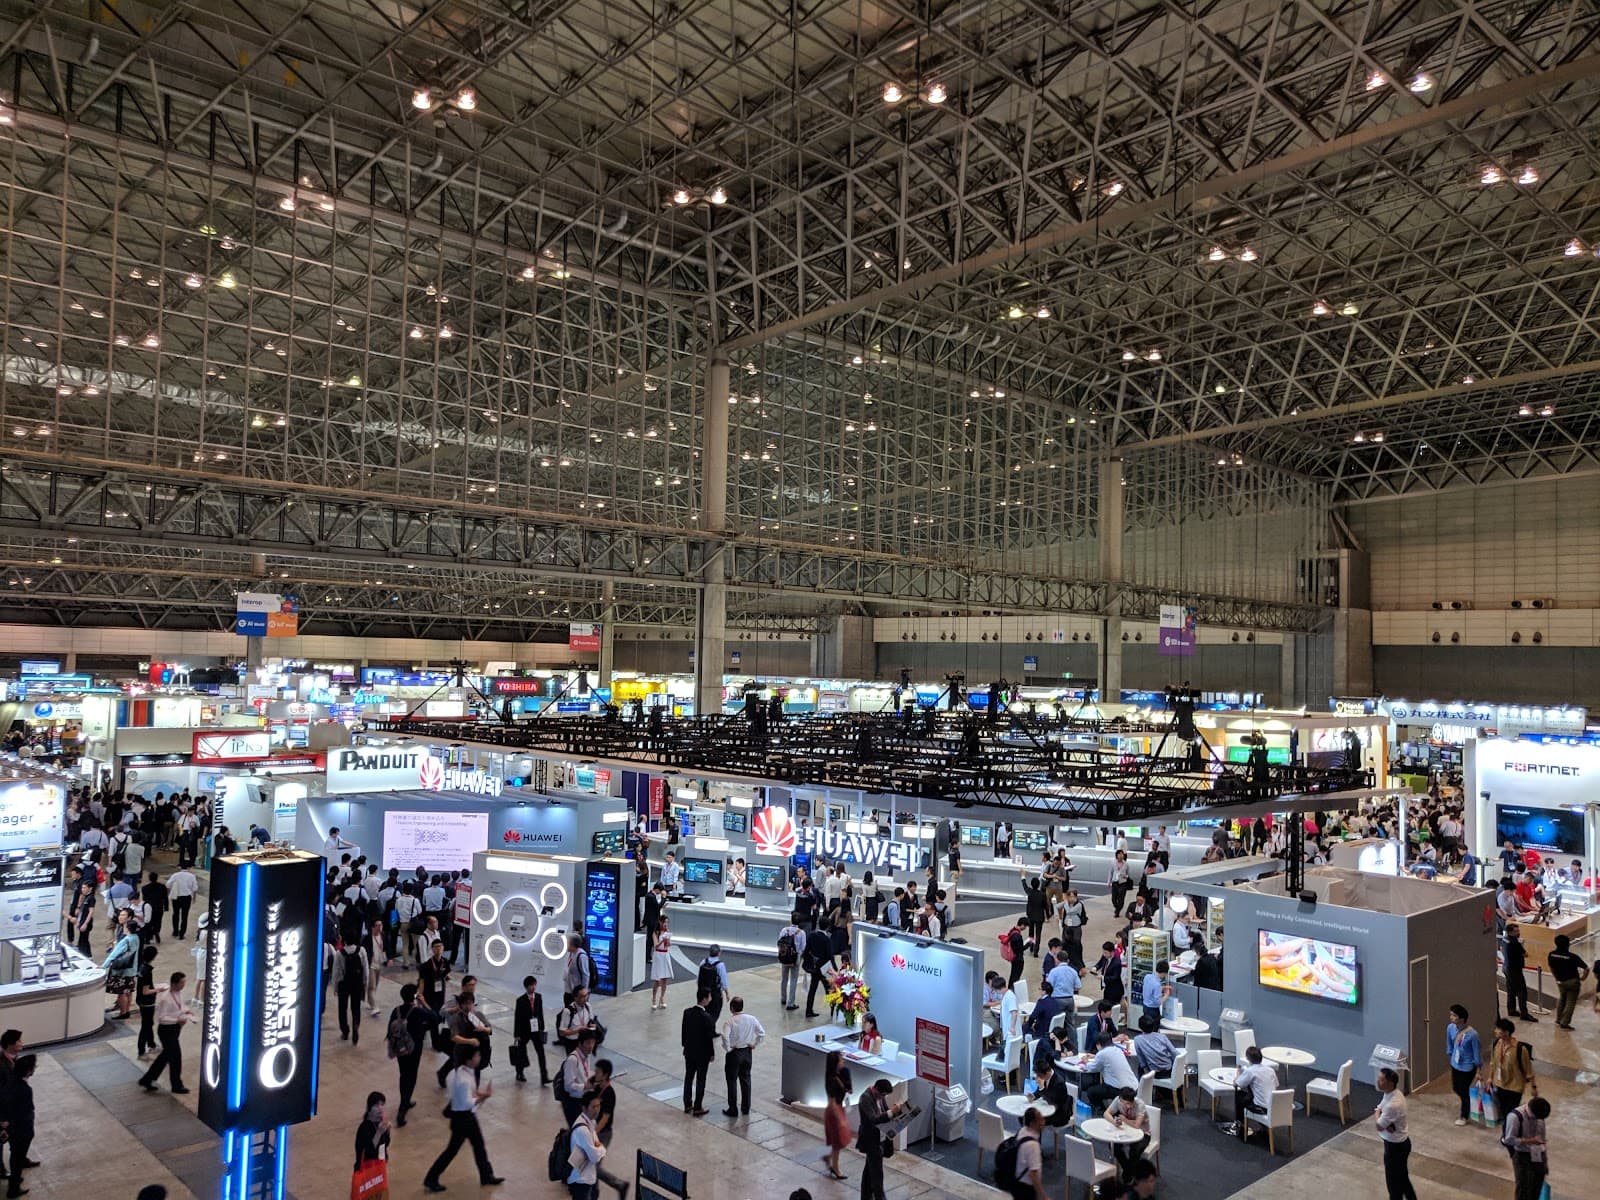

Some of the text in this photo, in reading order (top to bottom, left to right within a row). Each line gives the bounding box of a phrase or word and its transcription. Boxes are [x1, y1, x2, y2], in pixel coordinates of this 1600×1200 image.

[496, 682, 537, 692] TOSHIBA
[1409, 709, 1493, 721] 丸文株式会社
[339, 751, 418, 771] PANDUIT
[444, 769, 502, 797] HUAWEI
[523, 833, 562, 842] HUAWEI
[796, 826, 920, 873] HUAWEI
[1256, 910, 1277, 919] Building
[1281, 914, 1295, 922] Fully
[1323, 919, 1352, 931] Intelligent
[1352, 925, 1369, 934] World
[907, 960, 942, 977] HUAWEI
[276, 928, 300, 1043] SHOWNET
